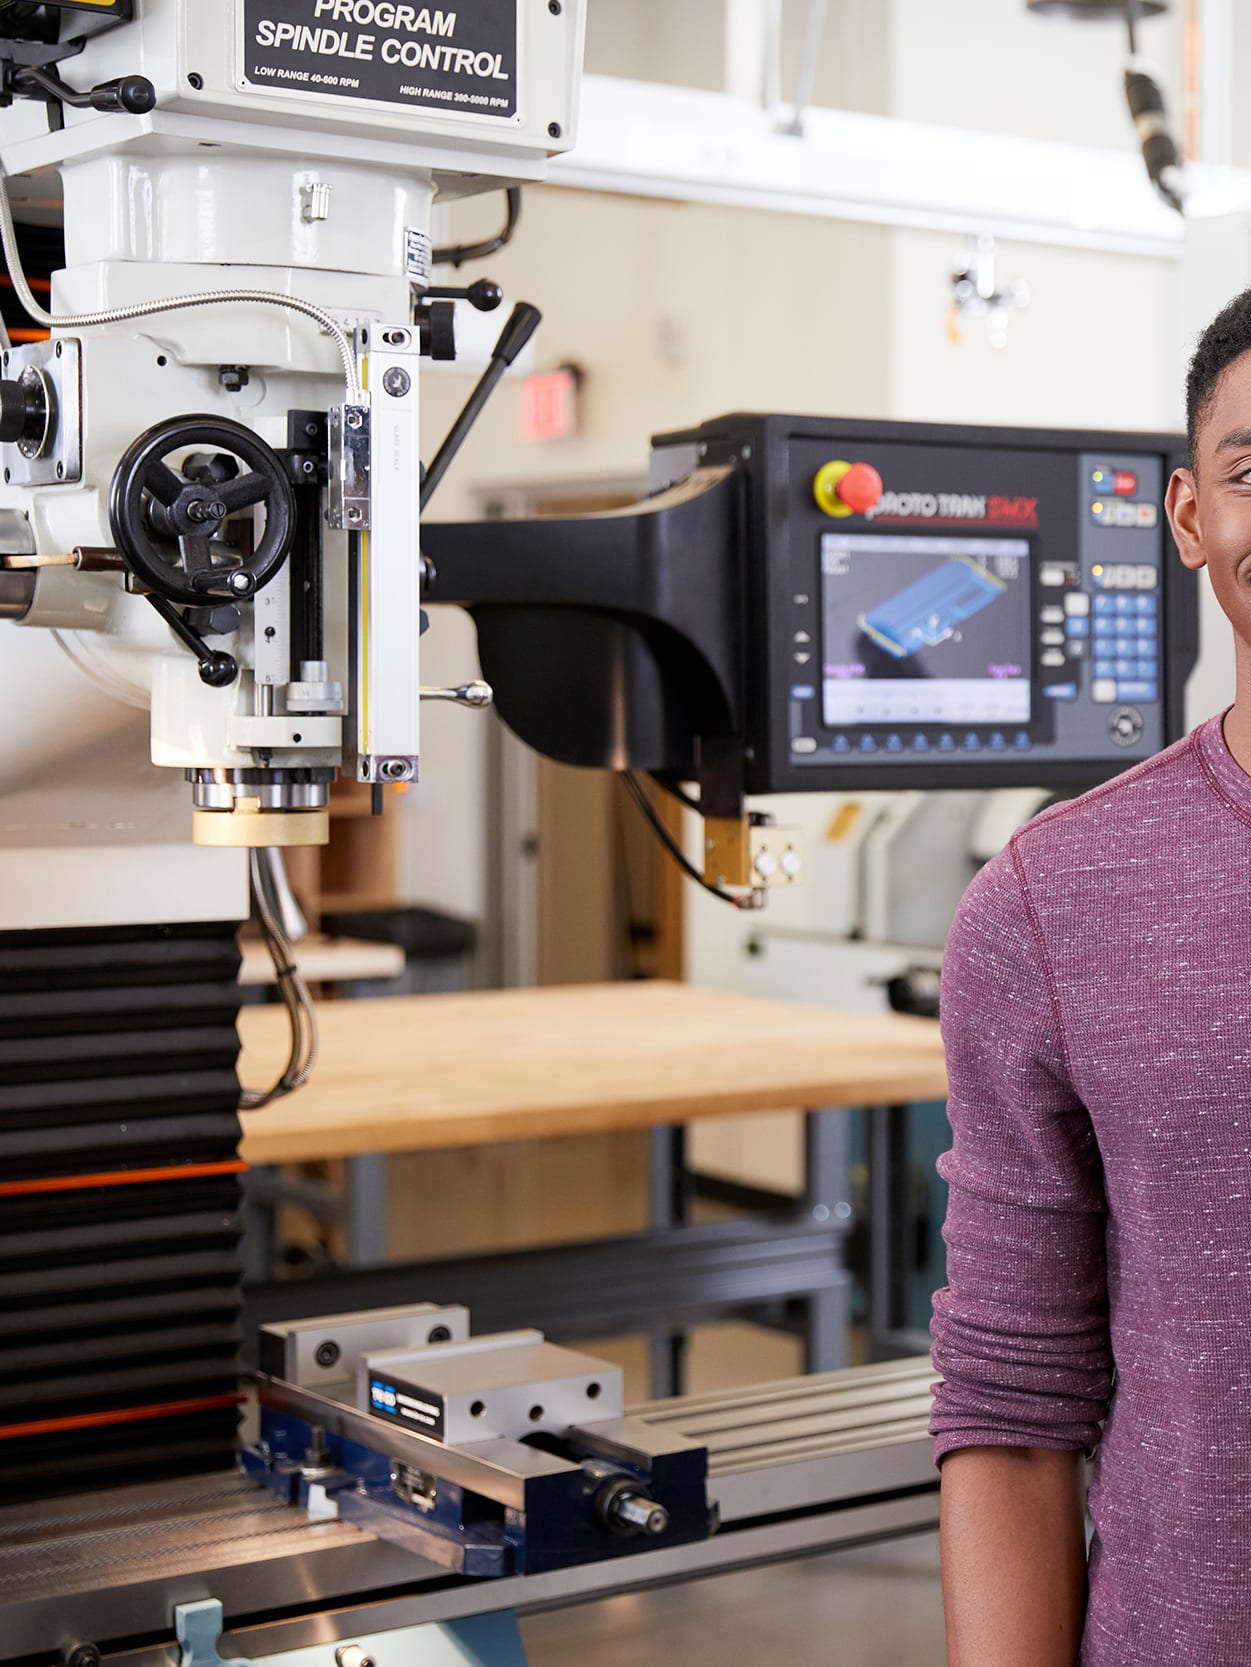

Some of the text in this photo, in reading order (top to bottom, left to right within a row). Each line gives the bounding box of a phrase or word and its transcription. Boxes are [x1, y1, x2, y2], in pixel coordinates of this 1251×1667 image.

[314, 0, 457, 37] PROGRAM
[255, 20, 509, 80] SPINDLE CONTROL
[254, 66, 360, 88] LOW RANGE 40-600 RPM
[400, 85, 421, 97] HIGH
[422, 88, 453, 101] RANGE
[489, 97, 509, 108] RPM
